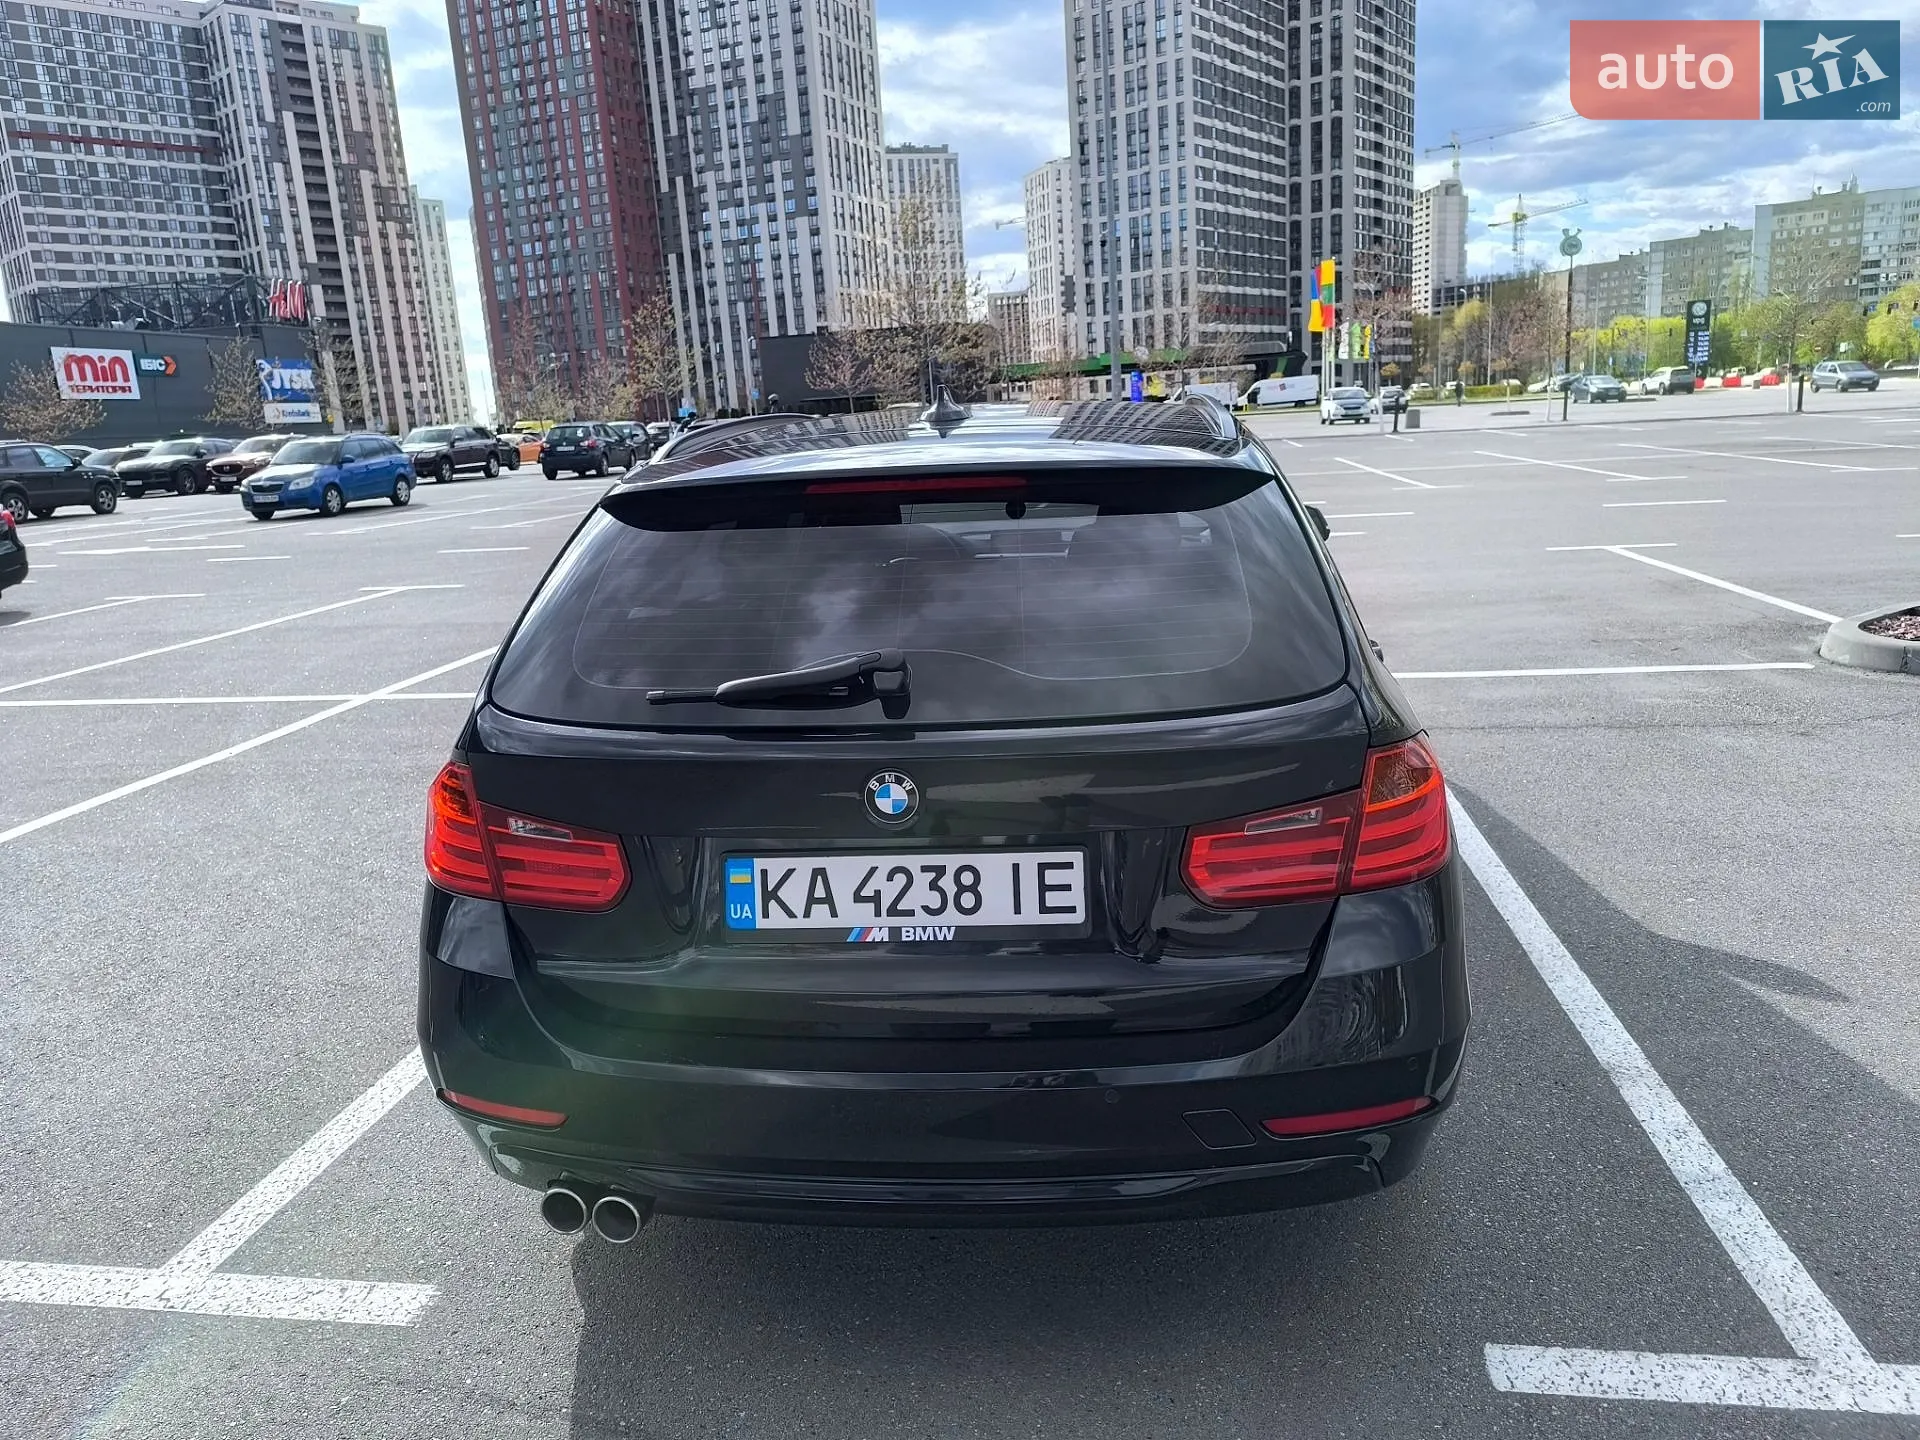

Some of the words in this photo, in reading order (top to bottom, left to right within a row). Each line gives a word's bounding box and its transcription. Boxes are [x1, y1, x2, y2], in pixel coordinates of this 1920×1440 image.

[267, 278, 305, 320] H&M
[271, 368, 315, 390] JYSK
[869, 773, 914, 792] BMW
[760, 867, 839, 920] KA
[853, 864, 983, 918] 4238
[1012, 861, 1078, 916] IE
[730, 904, 753, 919] UA
[901, 926, 956, 942] BMW
